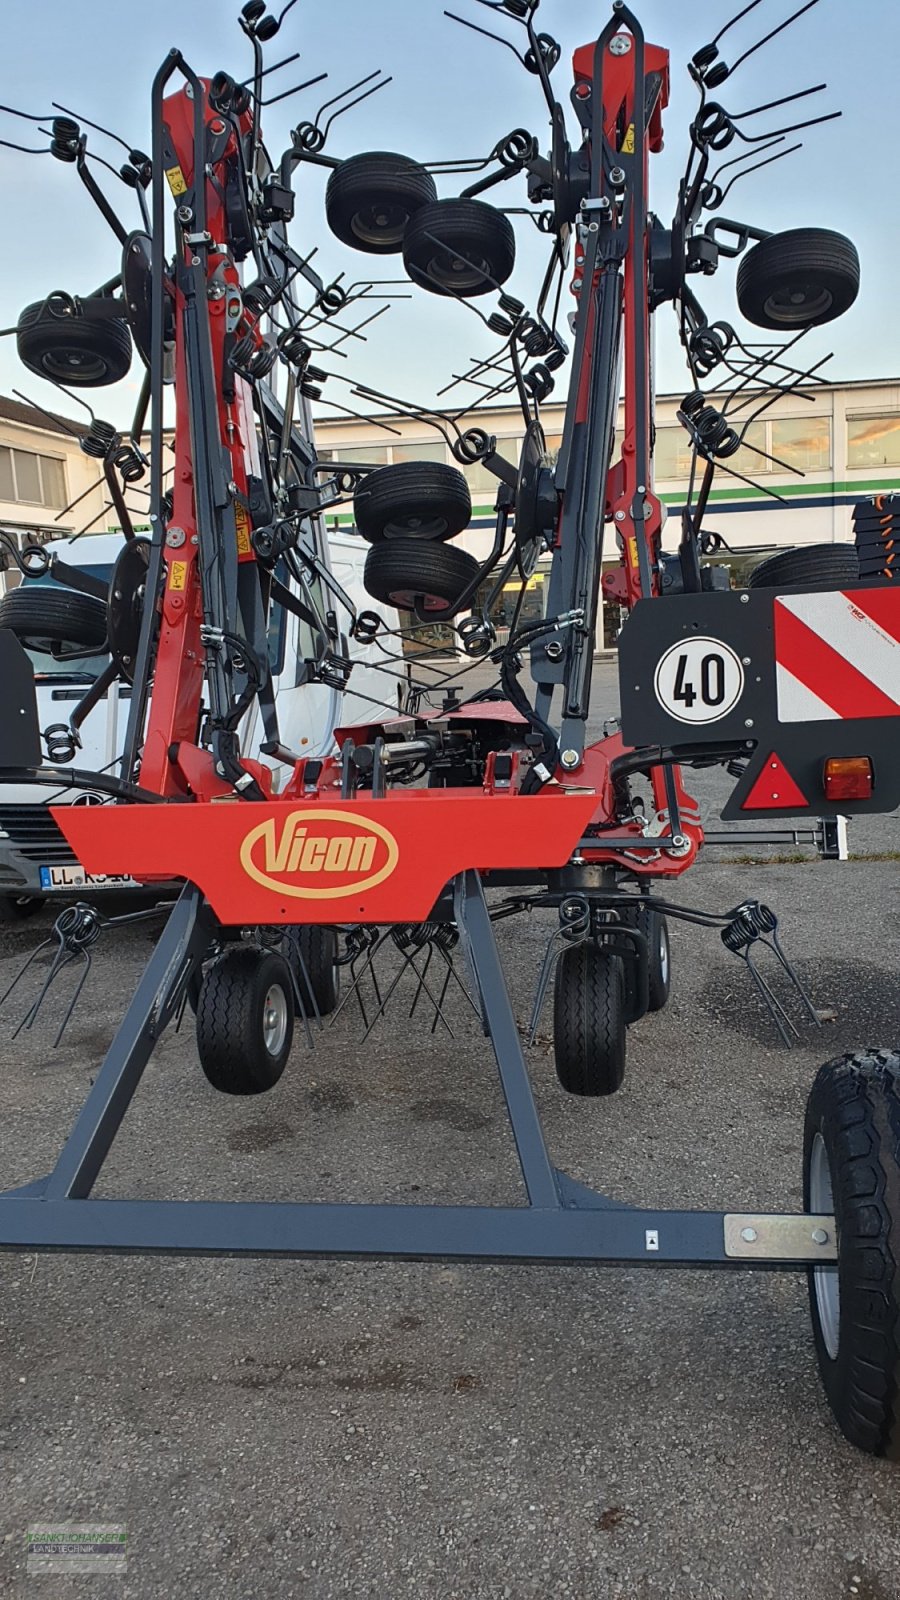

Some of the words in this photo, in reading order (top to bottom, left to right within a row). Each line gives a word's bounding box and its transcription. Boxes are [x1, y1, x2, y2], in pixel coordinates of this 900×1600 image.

[673, 653, 725, 707] 40
[264, 817, 378, 872] Vicon
[51, 869, 73, 885] LL
